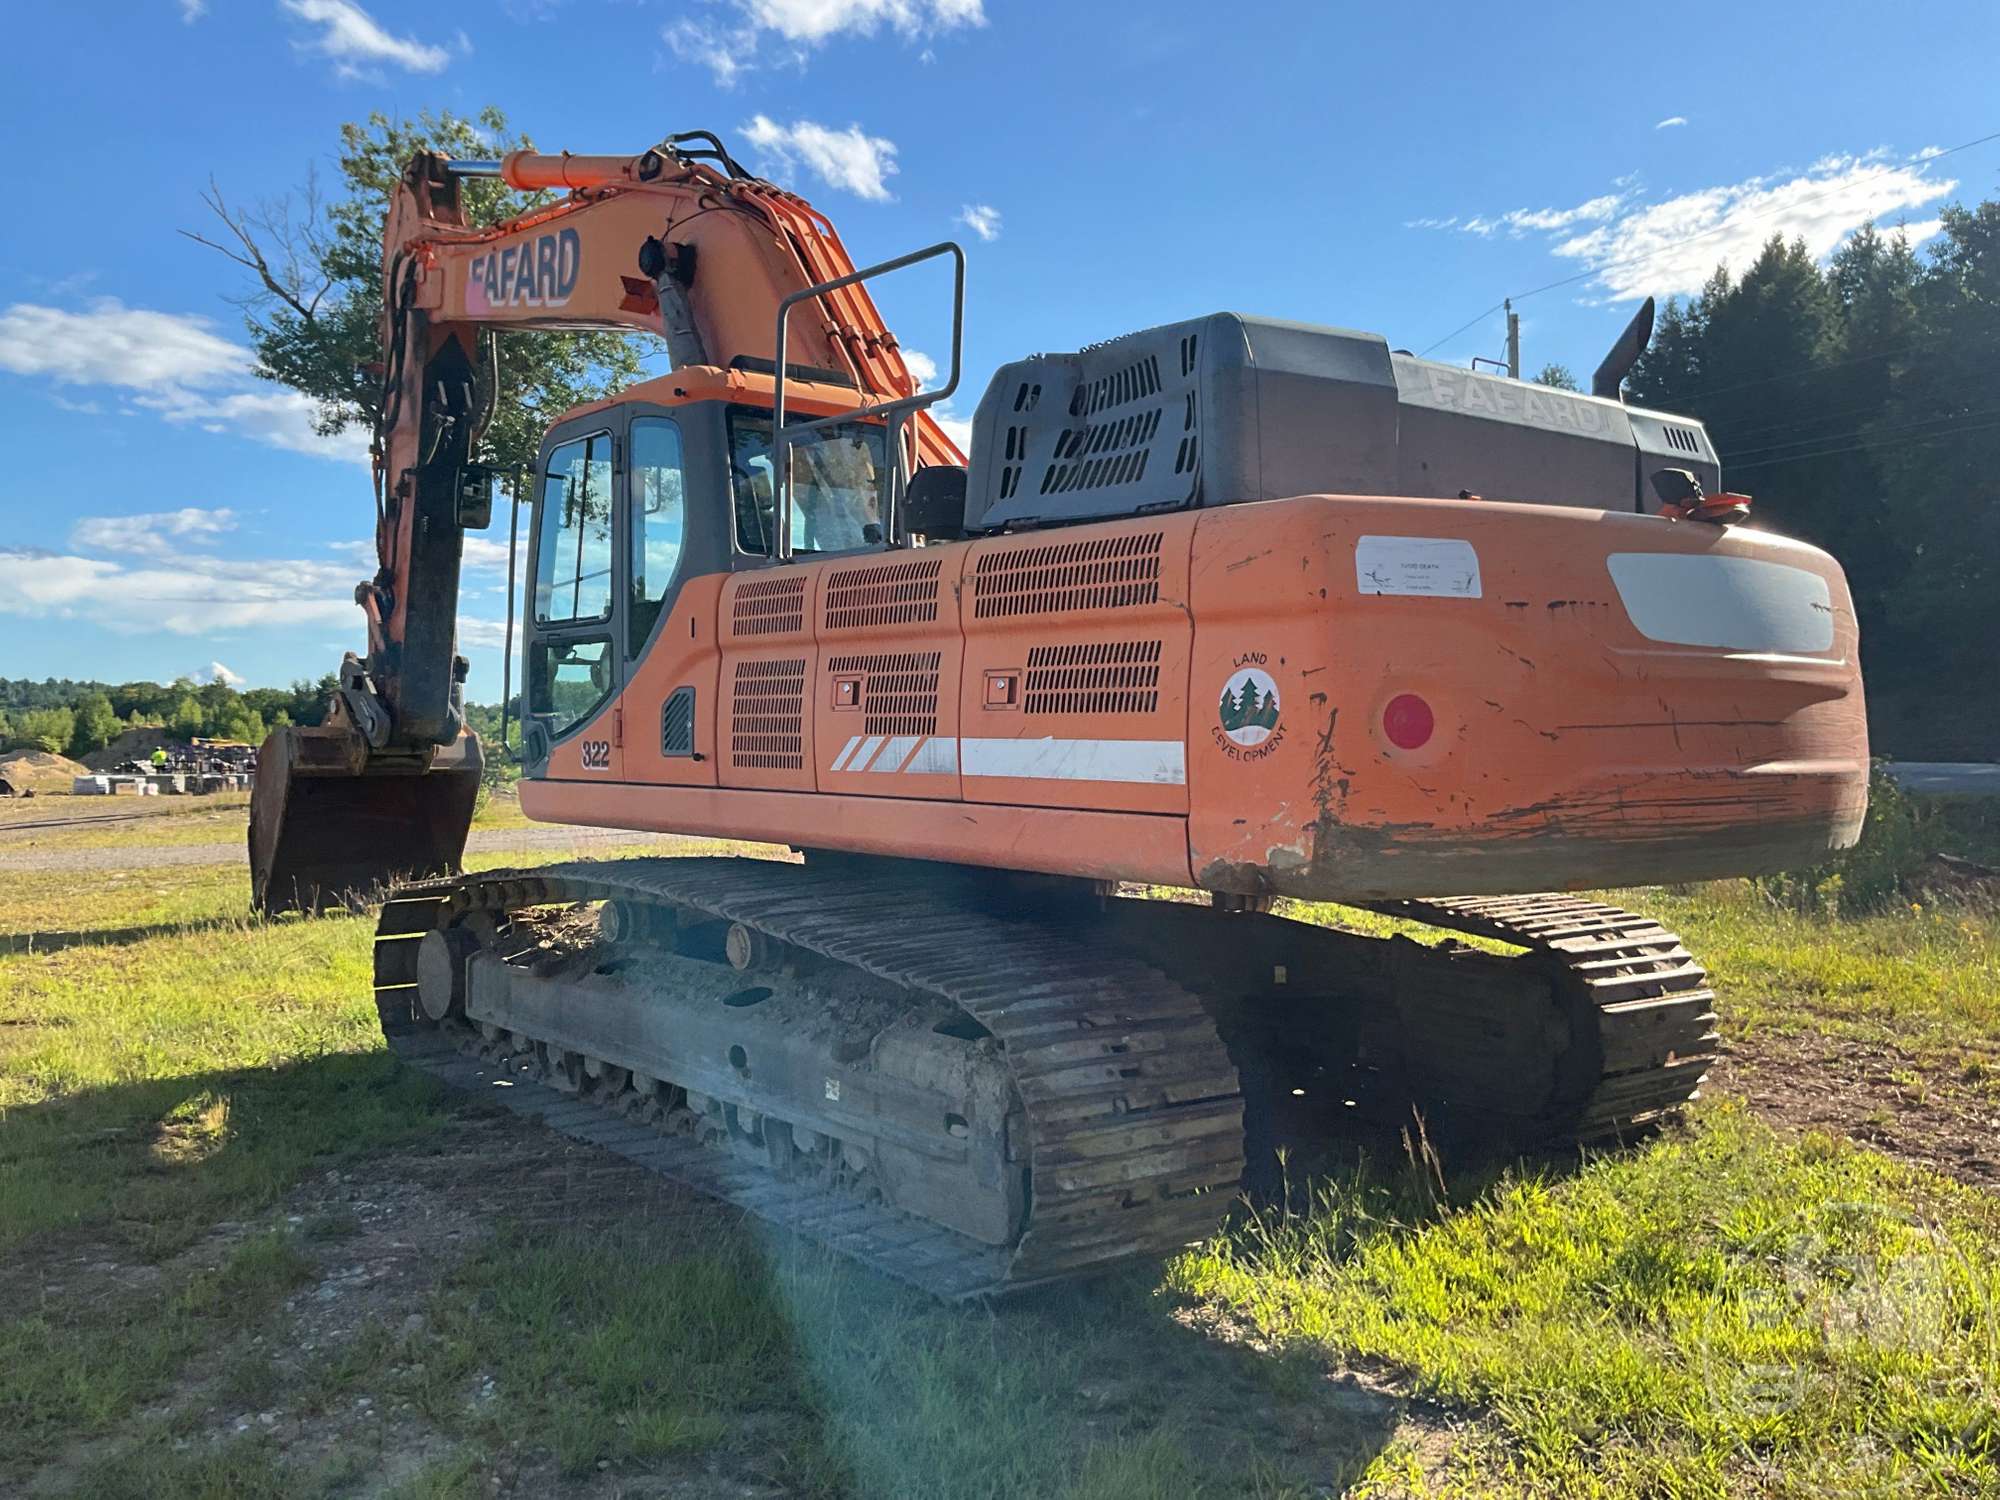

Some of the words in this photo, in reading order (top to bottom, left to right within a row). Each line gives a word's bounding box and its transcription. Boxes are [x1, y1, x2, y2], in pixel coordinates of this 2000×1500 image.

[468, 227, 580, 307] FAFARD
[1427, 365, 1602, 434] FAFARD
[1233, 652, 1267, 667] LAND
[582, 741, 609, 770] 322
